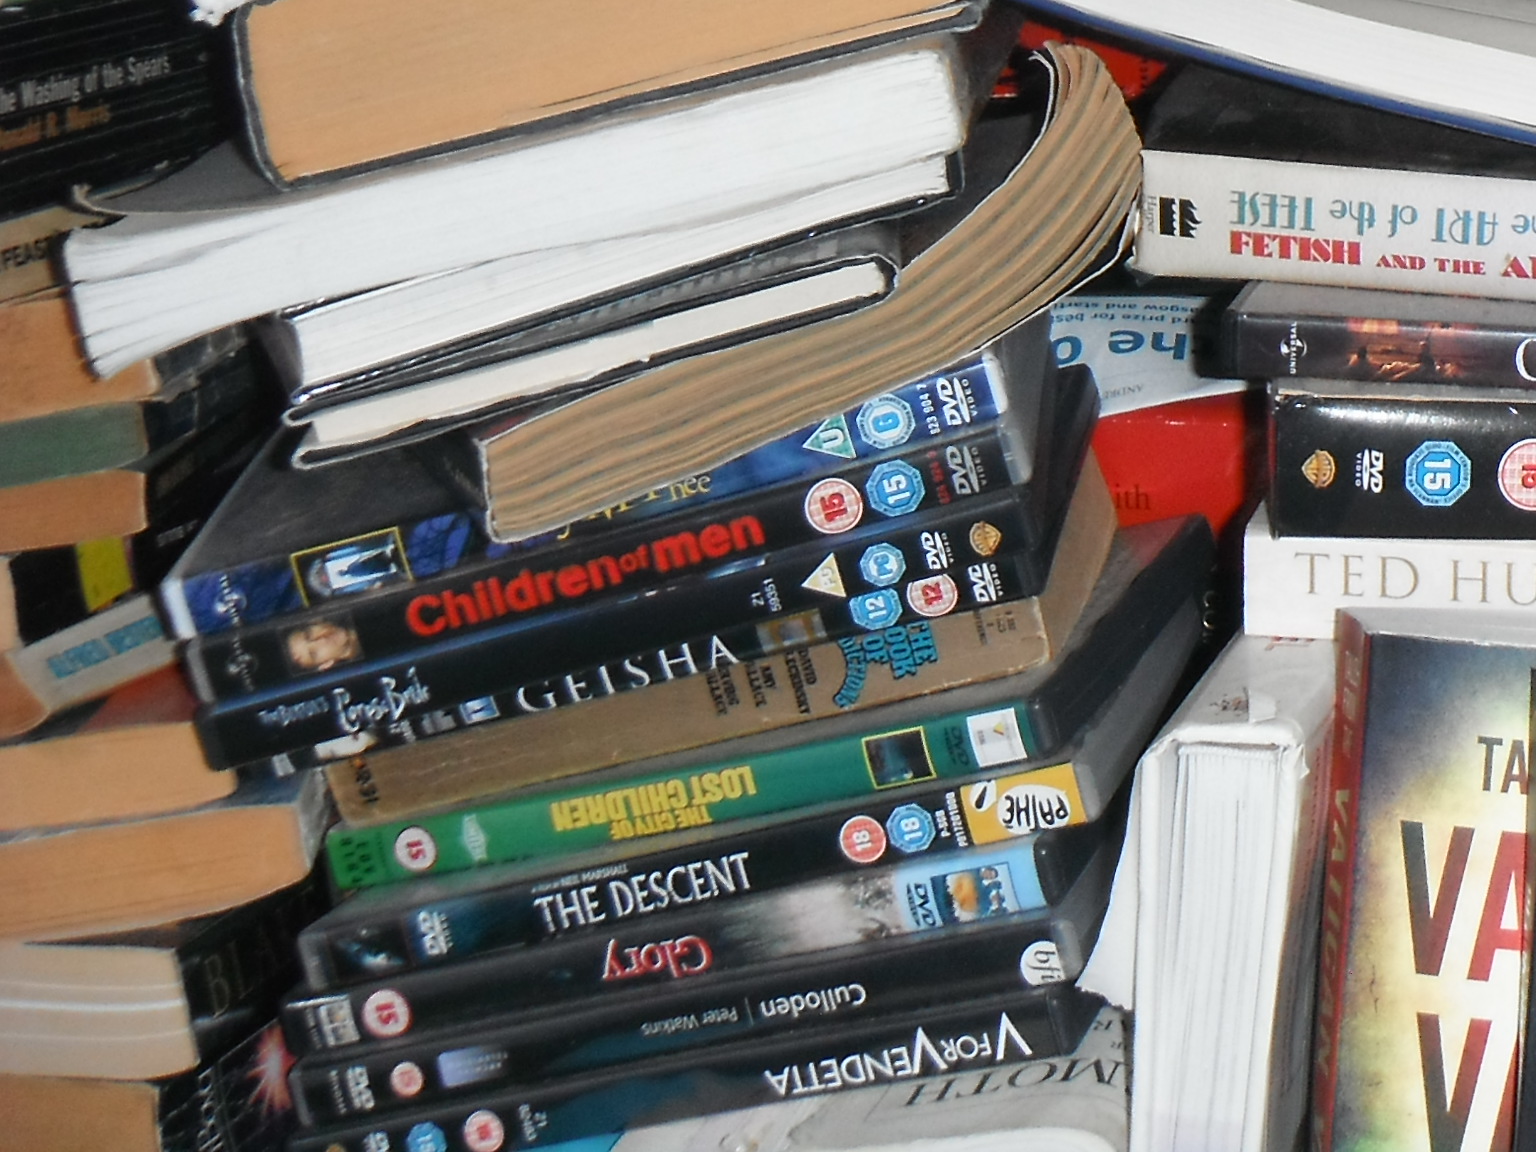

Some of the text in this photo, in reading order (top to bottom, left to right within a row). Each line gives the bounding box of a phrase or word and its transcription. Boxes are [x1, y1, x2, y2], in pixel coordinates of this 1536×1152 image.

[1229, 190, 1315, 232] TEESE
[1330, 200, 1376, 236] the
[1388, 205, 1418, 236] of
[1432, 207, 1497, 246] ART
[1229, 230, 1361, 266] FETISH
[1376, 253, 1426, 271] AND
[1434, 258, 1486, 276] THE
[937, 377, 956, 426] DVD
[962, 379, 978, 418] VIDEO
[822, 428, 842, 448] U
[946, 446, 966, 495] DVD
[973, 447, 987, 486] VIDEO
[1355, 452, 1363, 487] VIDEO
[1370, 450, 1384, 494] DVD
[1423, 459, 1451, 490] 15
[820, 493, 848, 522] 15
[887, 474, 907, 502] 15
[922, 532, 941, 570] DVD
[405, 514, 765, 636] Children of men
[924, 579, 942, 608] 12
[968, 562, 986, 602] DVD
[1294, 552, 1420, 599] TED
[866, 596, 885, 619] 12
[864, 636, 888, 666] OF
[516, 635, 740, 713] GEISHA
[550, 765, 757, 832] LOST CHILDREN
[611, 805, 714, 840] THE CITY OF
[853, 830, 871, 849] 18
[900, 818, 919, 840] 18
[407, 841, 426, 860] 15
[534, 852, 750, 932] THE DESCENT
[914, 883, 936, 927] DVD
[602, 935, 713, 981] Glory
[1034, 949, 1059, 980] bfi
[375, 1004, 395, 1025] 15
[642, 983, 867, 1038] Culloden Peter Watkins
[944, 1033, 991, 1061] FOR
[996, 1012, 1031, 1059] V
[764, 1026, 948, 1097] VENDETTA
